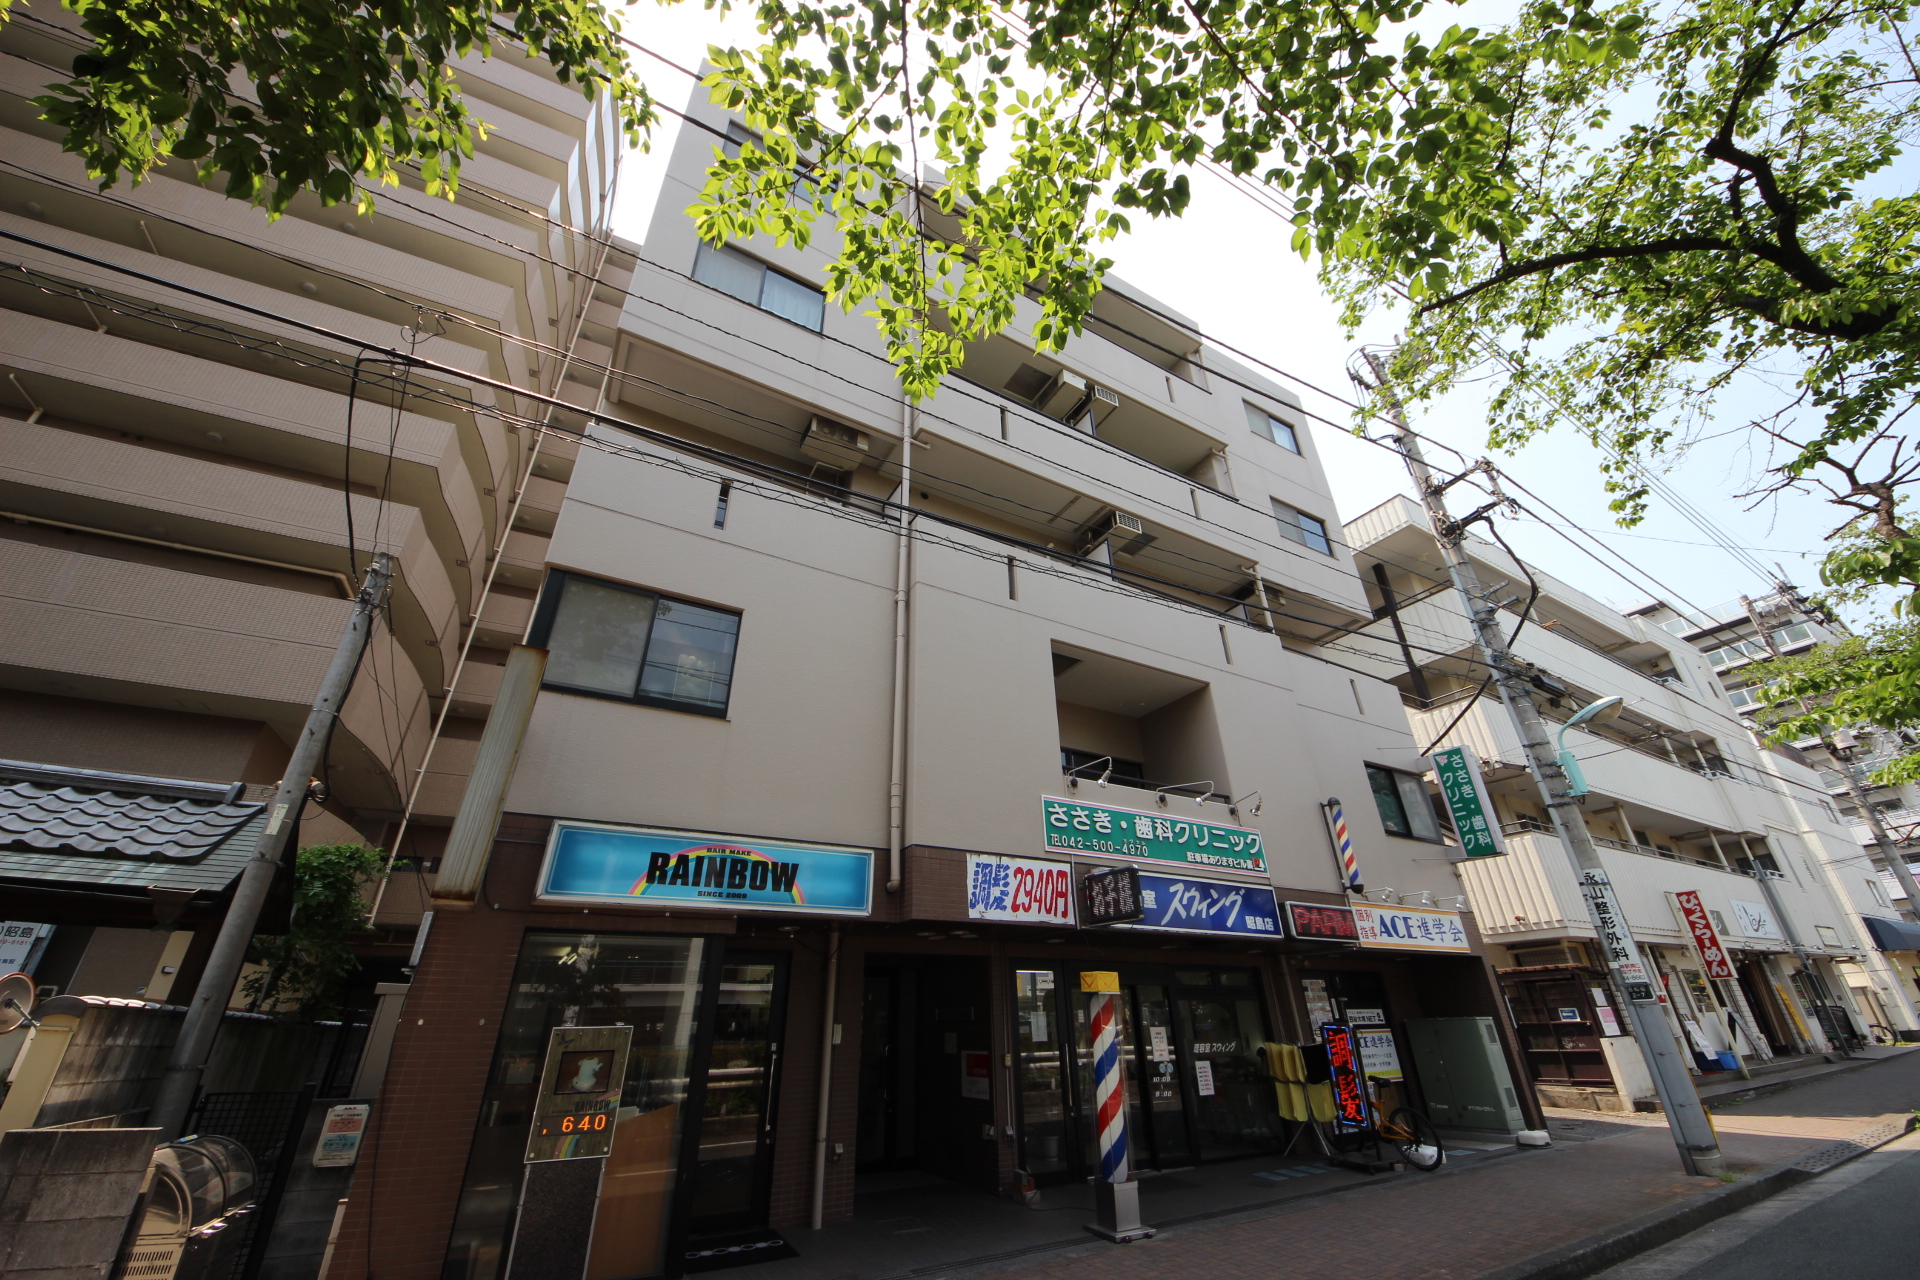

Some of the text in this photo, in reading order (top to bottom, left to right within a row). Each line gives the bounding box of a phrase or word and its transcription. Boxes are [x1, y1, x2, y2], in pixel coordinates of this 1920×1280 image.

[1442, 772, 1476, 850] クリニック
[1450, 754, 1492, 847] ささき・歯科
[1047, 803, 1260, 854] ささき・歯科クリニック
[645, 851, 800, 893] RAINBOW
[706, 847, 752, 857] HAIR MAKE
[697, 890, 724, 898] SINCE
[1011, 866, 1069, 919] 2940円
[1160, 882, 1246, 928] スウィング
[1244, 915, 1275, 932] 昭島店
[1355, 908, 1375, 924] 個別
[1359, 925, 1378, 940] 指導
